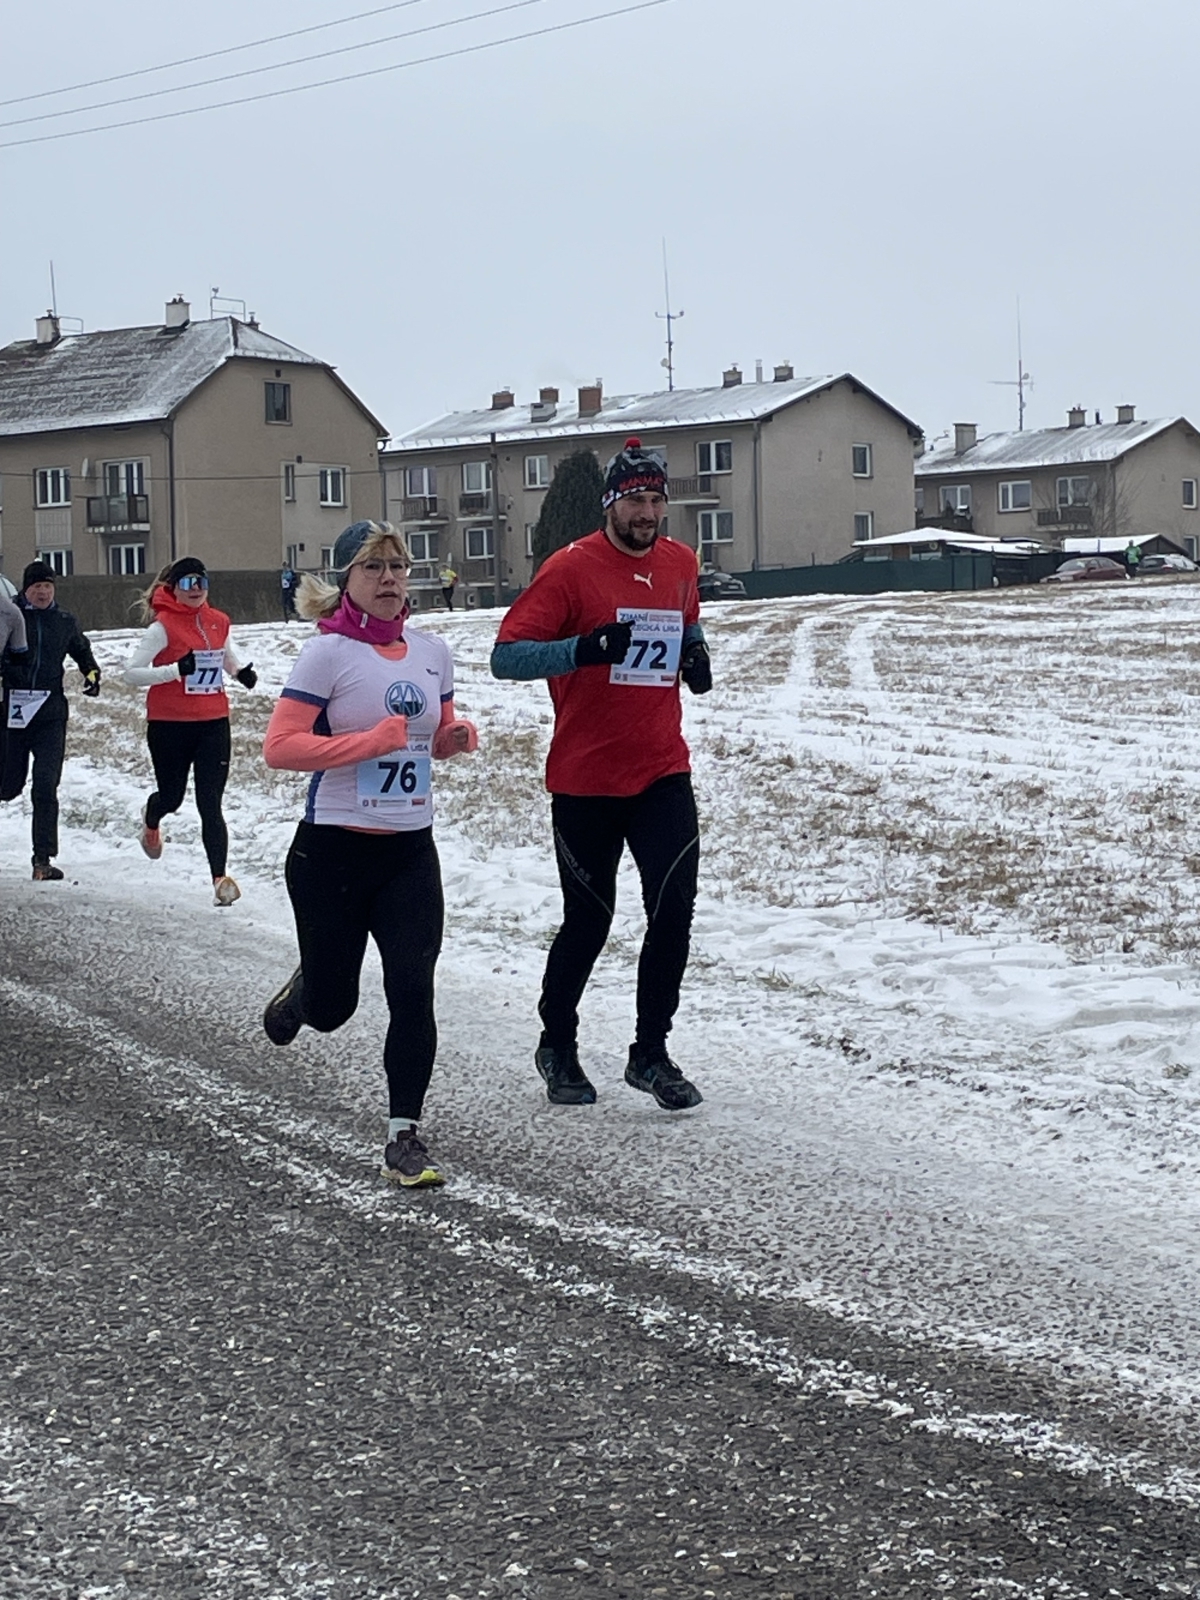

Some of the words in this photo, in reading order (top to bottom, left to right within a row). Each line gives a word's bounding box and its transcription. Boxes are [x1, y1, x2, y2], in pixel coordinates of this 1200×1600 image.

[630, 640, 668, 670] 72
[197, 667, 219, 685] 77
[378, 760, 417, 794] 76
